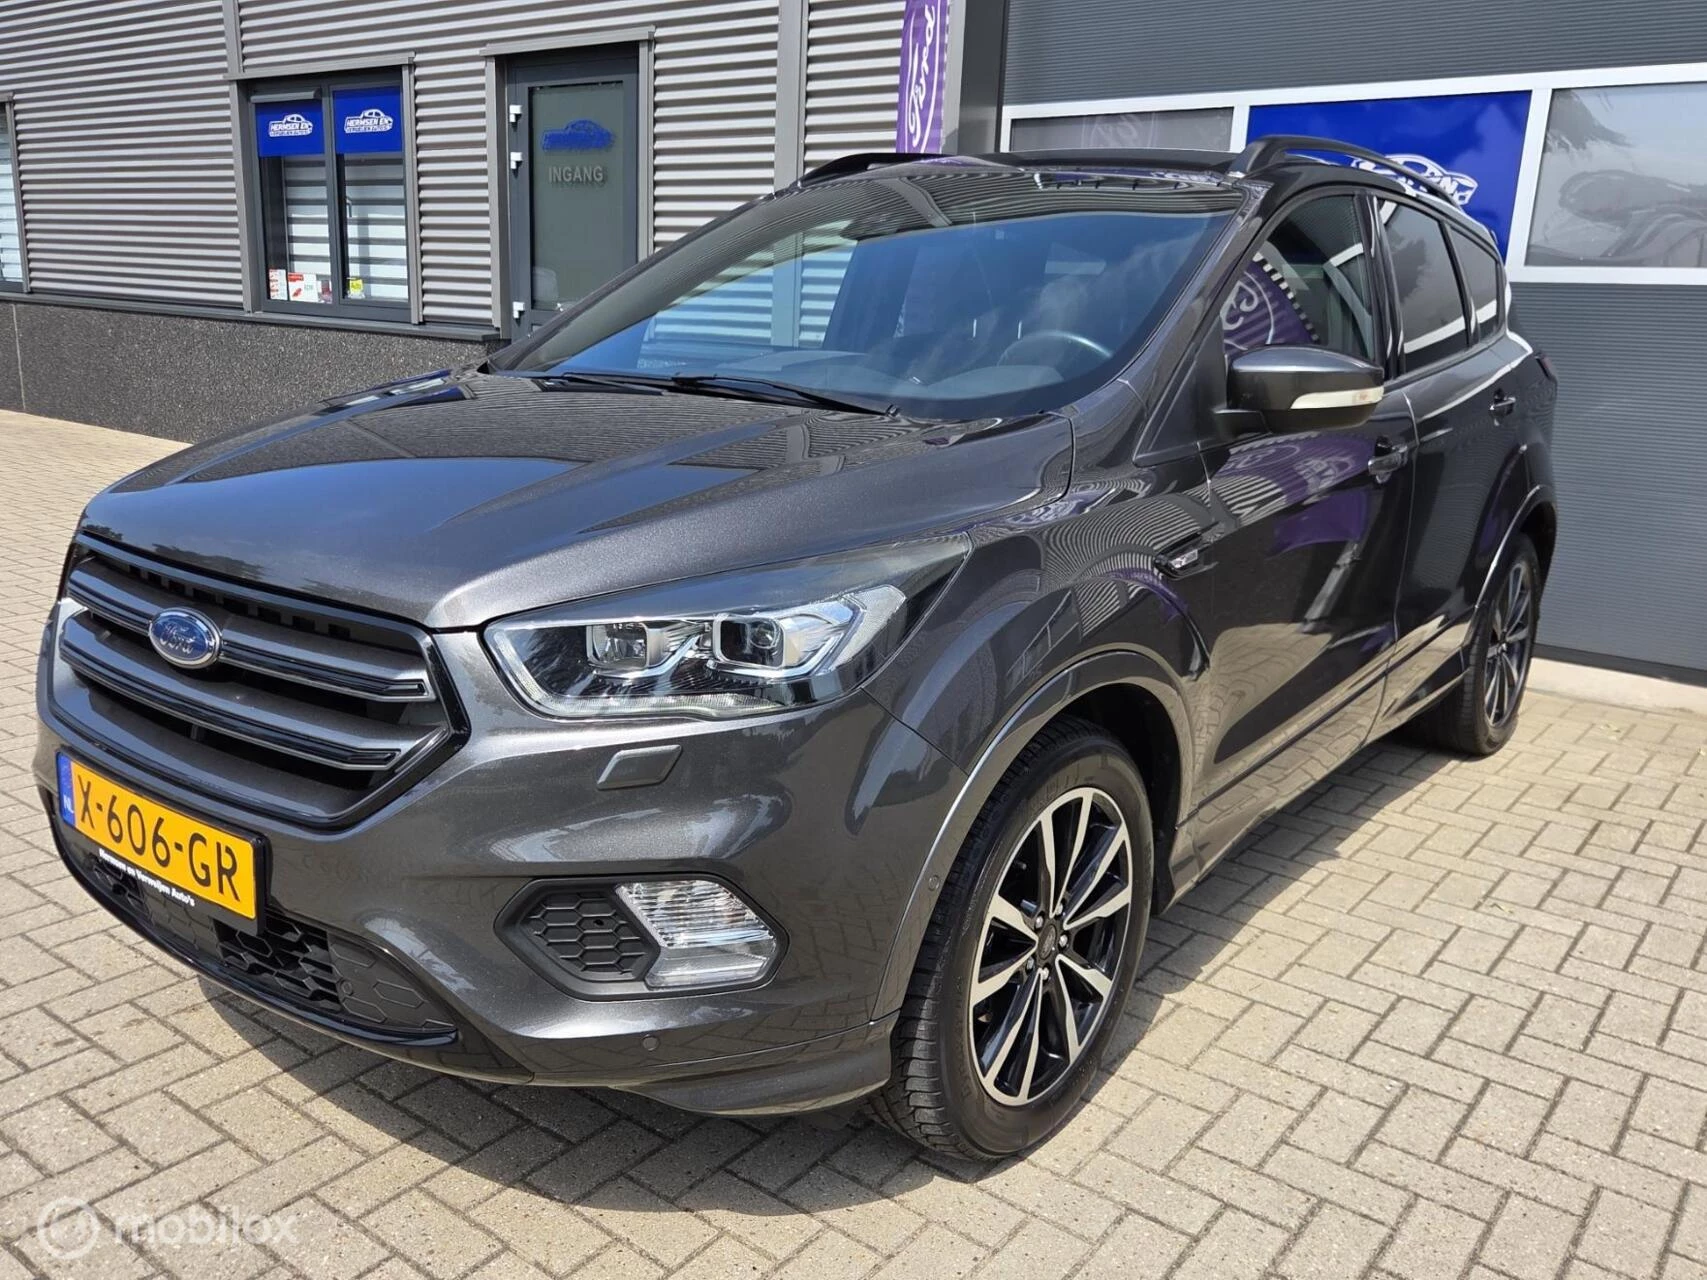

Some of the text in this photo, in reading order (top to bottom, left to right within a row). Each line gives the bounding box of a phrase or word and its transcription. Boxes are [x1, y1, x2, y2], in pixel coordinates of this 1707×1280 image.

[908, 4, 936, 148] Ford
[548, 165, 604, 183] INGANG
[63, 795, 74, 813] NL
[77, 774, 241, 902] X-606-GR
